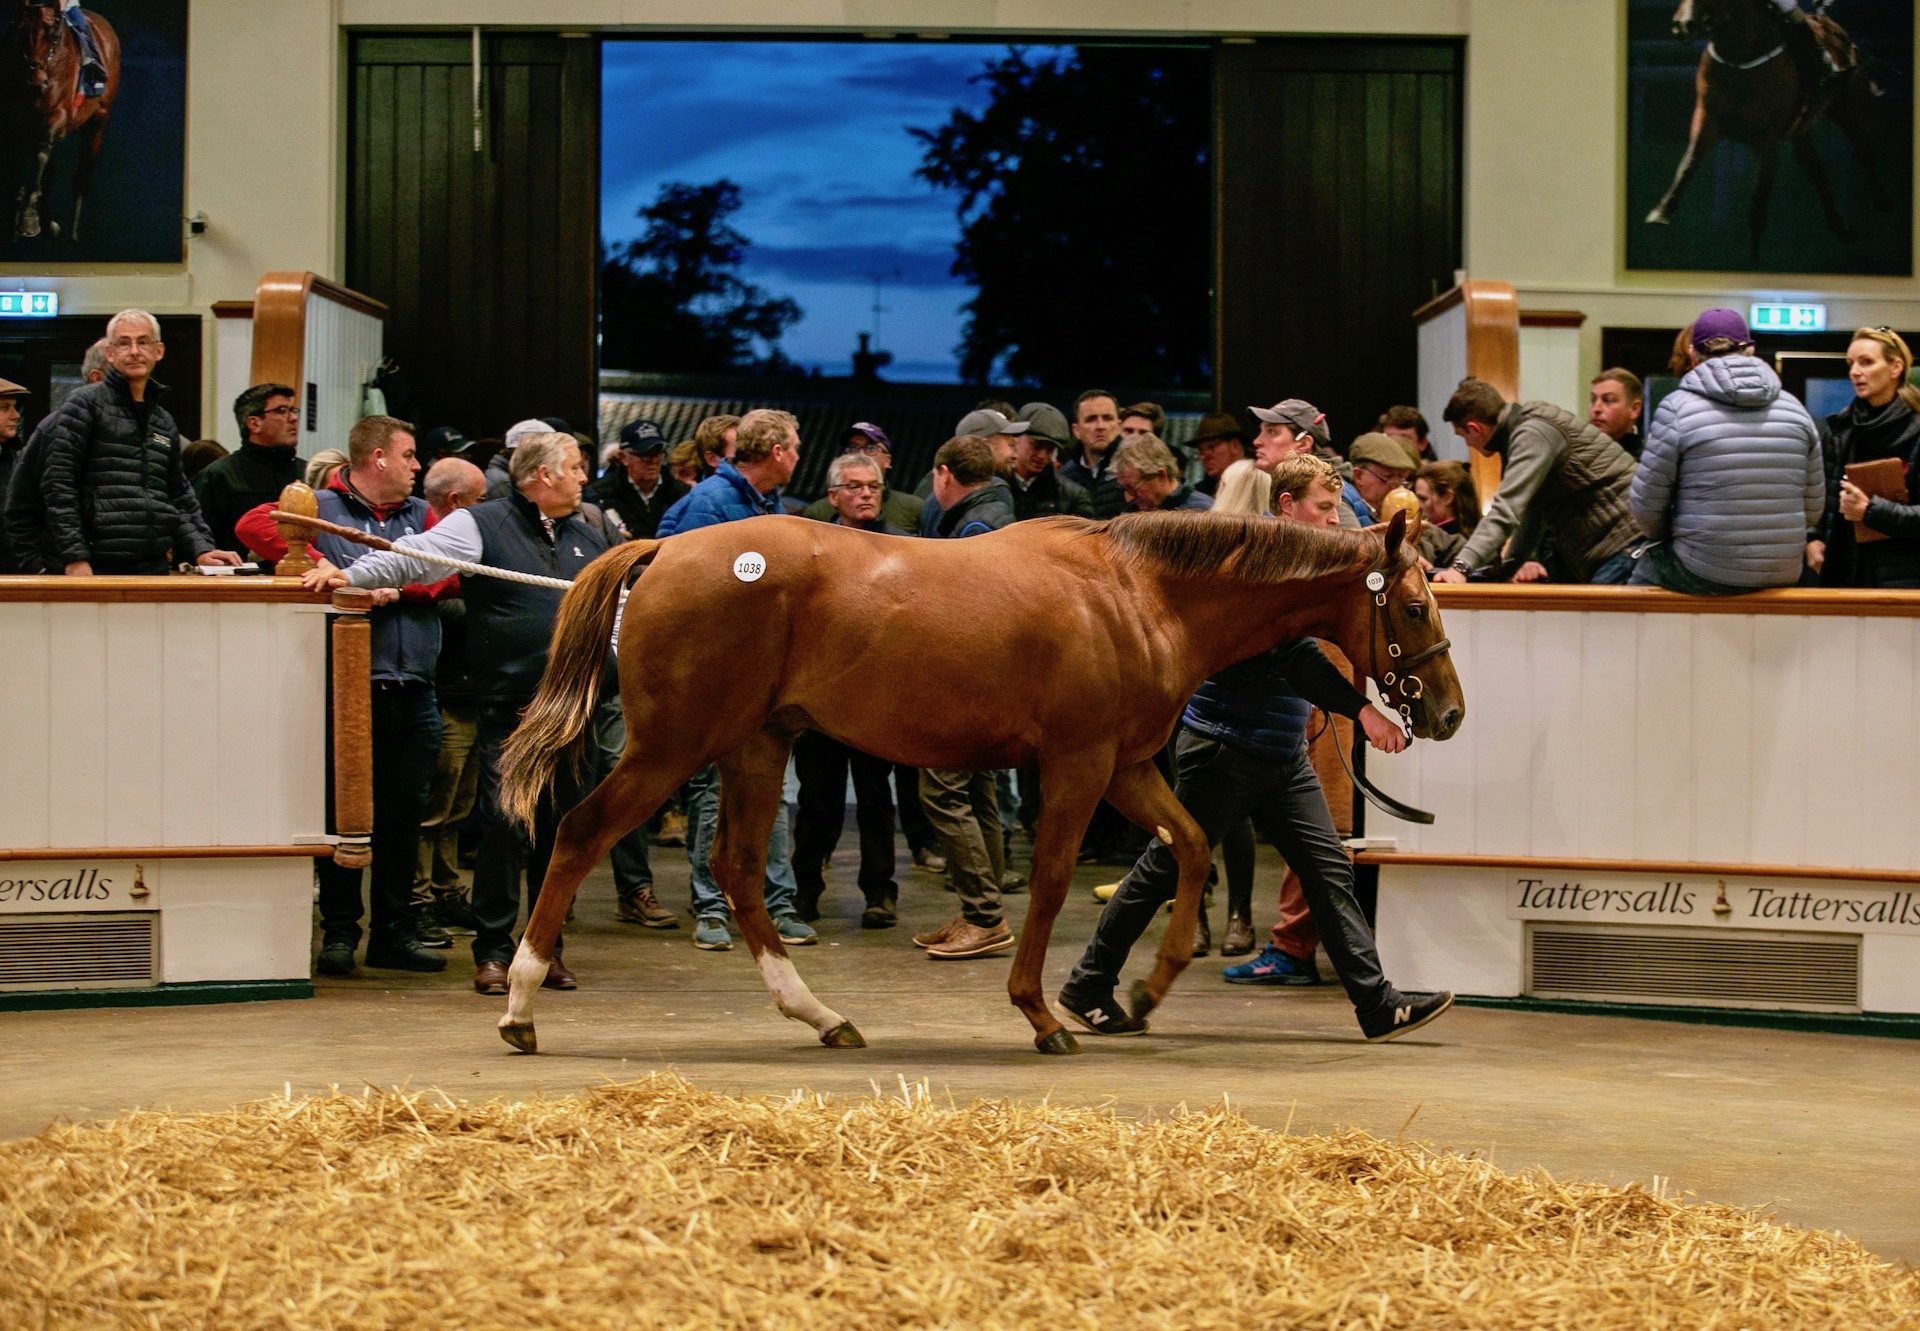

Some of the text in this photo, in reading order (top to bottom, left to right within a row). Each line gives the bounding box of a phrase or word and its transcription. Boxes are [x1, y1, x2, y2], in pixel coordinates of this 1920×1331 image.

[738, 562, 762, 575] 1038
[1516, 878, 1920, 926] Tattersalls Tattersalls
[1084, 1007, 1110, 1026] N
[1393, 1004, 1412, 1026] N
